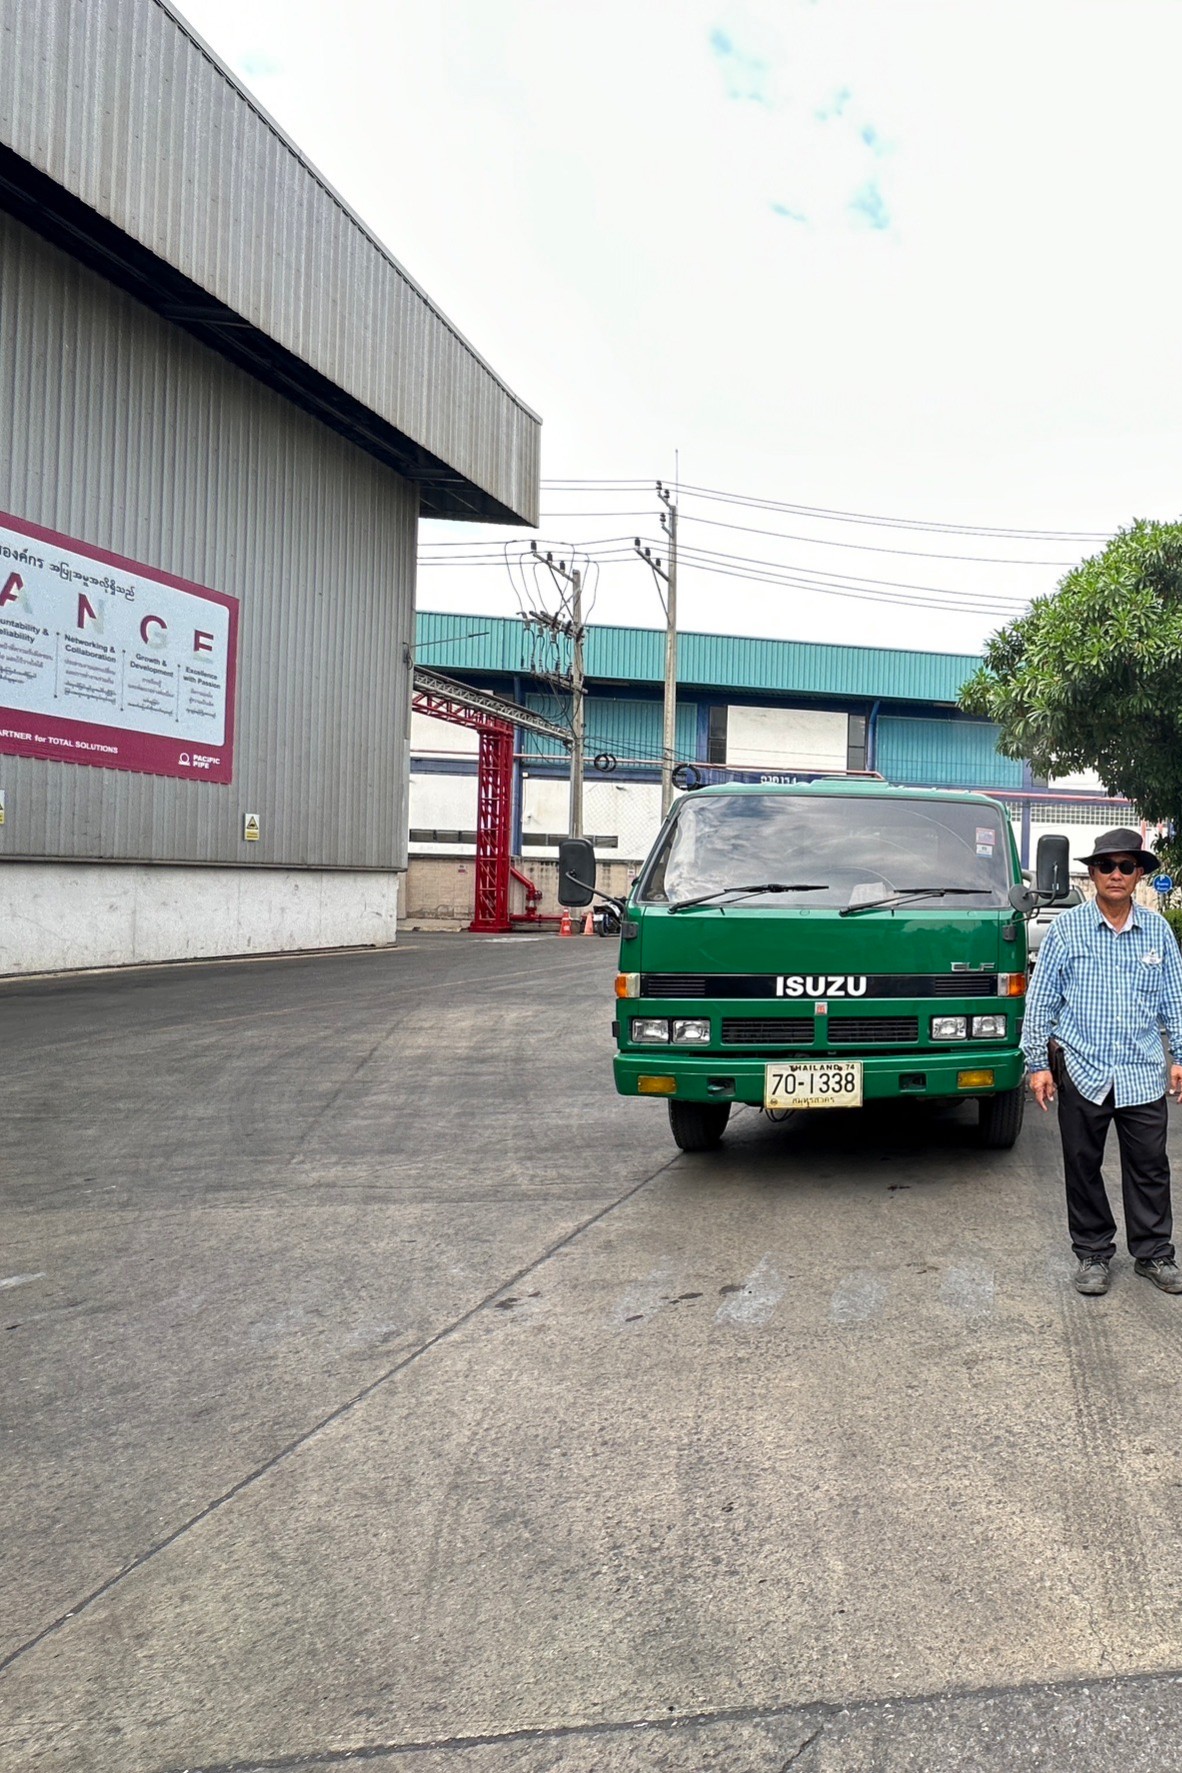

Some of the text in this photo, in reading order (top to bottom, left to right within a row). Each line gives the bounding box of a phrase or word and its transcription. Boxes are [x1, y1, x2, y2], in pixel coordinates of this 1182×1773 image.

[0, 545, 44, 569] องค์กร
[64, 634, 108, 653] Networking
[65, 644, 117, 663] Collaboration
[135, 653, 161, 665] Growth
[130, 660, 174, 677] Development
[186, 666, 218, 680] Excellence
[198, 678, 221, 689] Passion
[48, 736, 74, 747] TOTAL
[75, 741, 118, 754] SOLUTIONS
[193, 754, 220, 765] PACIFIC
[193, 761, 210, 769] PIPE
[951, 962, 995, 972] ELF
[775, 976, 867, 997] ISUZU
[789, 1064, 843, 1072] THAILAND
[772, 1072, 855, 1096] 70-1338
